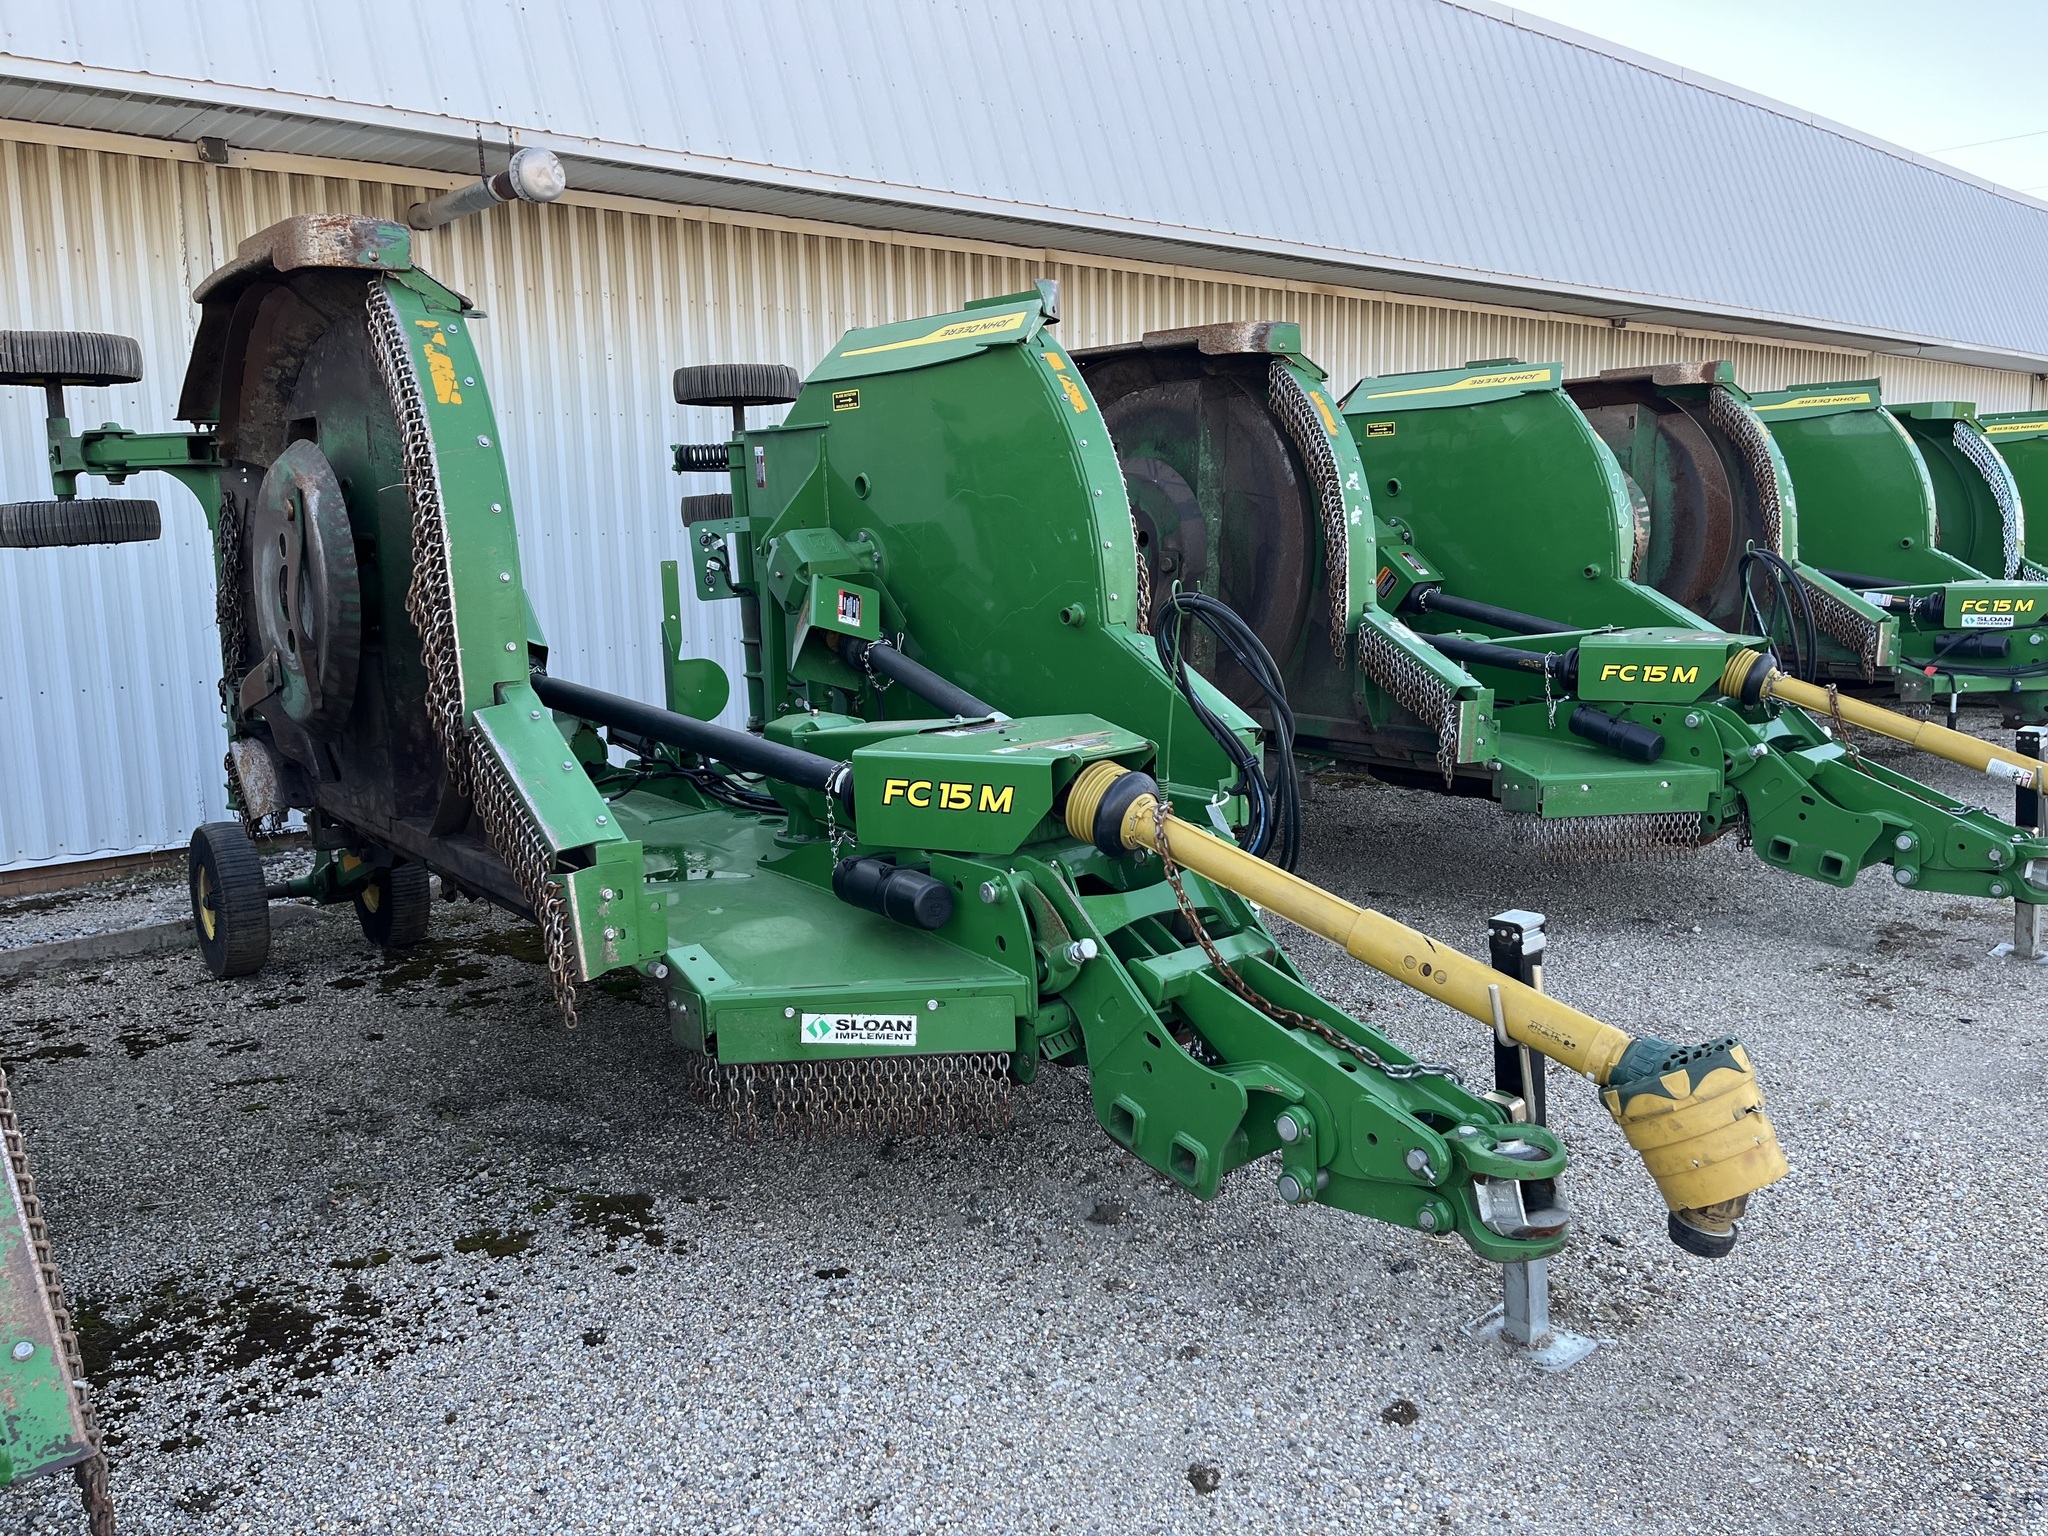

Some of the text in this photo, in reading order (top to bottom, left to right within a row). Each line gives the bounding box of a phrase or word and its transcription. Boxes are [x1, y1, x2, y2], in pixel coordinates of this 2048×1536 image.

[940, 318, 1014, 337] JOHN DEERE
[1469, 373, 1540, 386] JOHN DEERE
[1960, 599, 2035, 613] FC 15 M
[1600, 664, 1699, 684] FC 15 M
[882, 778, 1016, 814] FC 15 M
[835, 1019, 913, 1032] SLOAN
[835, 1032, 912, 1040] IMPLEMENT
